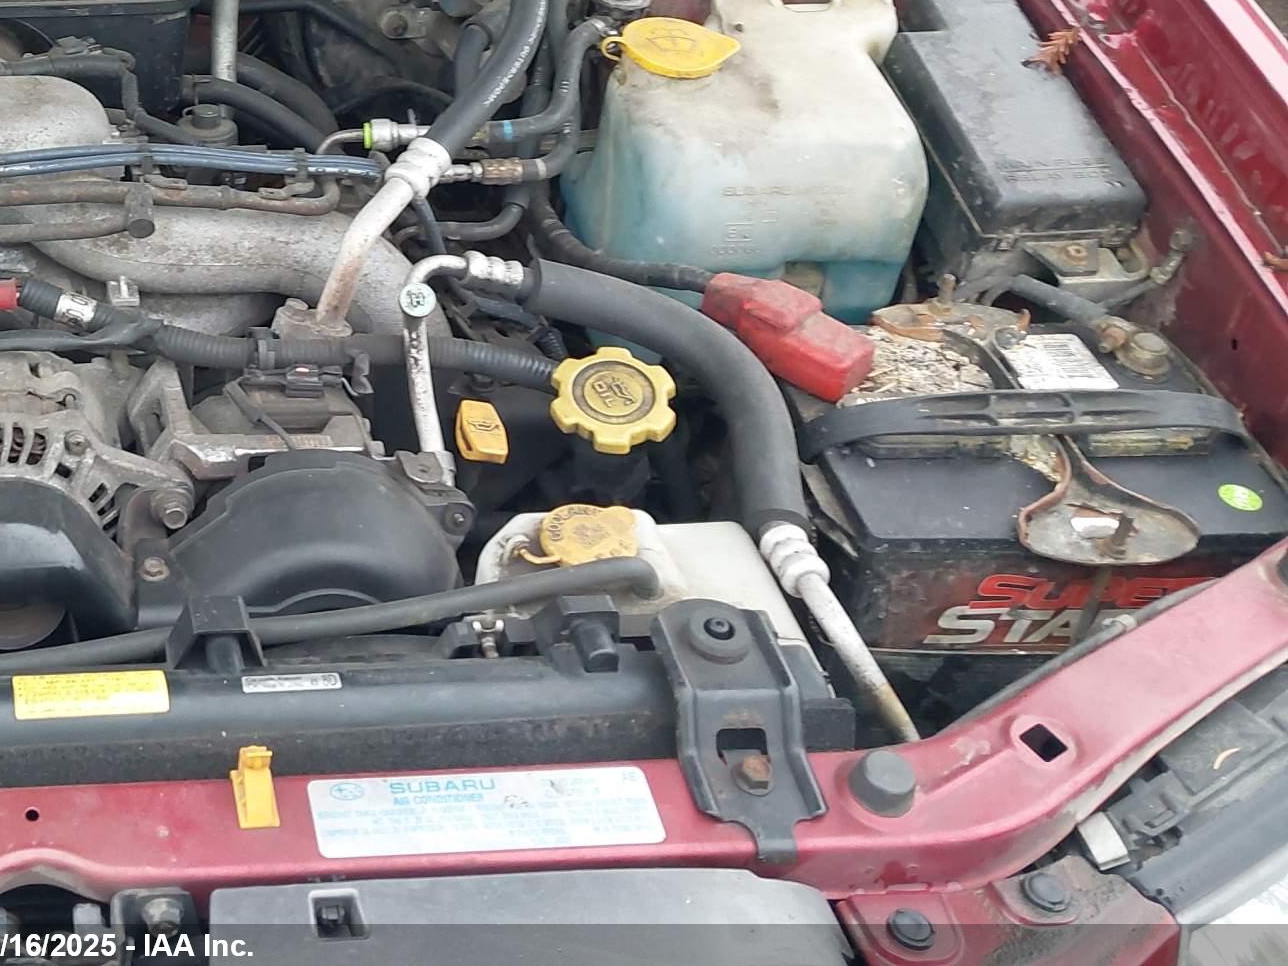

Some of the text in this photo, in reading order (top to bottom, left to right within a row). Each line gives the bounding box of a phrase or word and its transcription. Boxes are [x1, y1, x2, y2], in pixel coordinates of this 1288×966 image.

[592, 379, 615, 409] OIL
[389, 777, 496, 794] SUBARU
[413, 792, 484, 805] CONDITIONER
